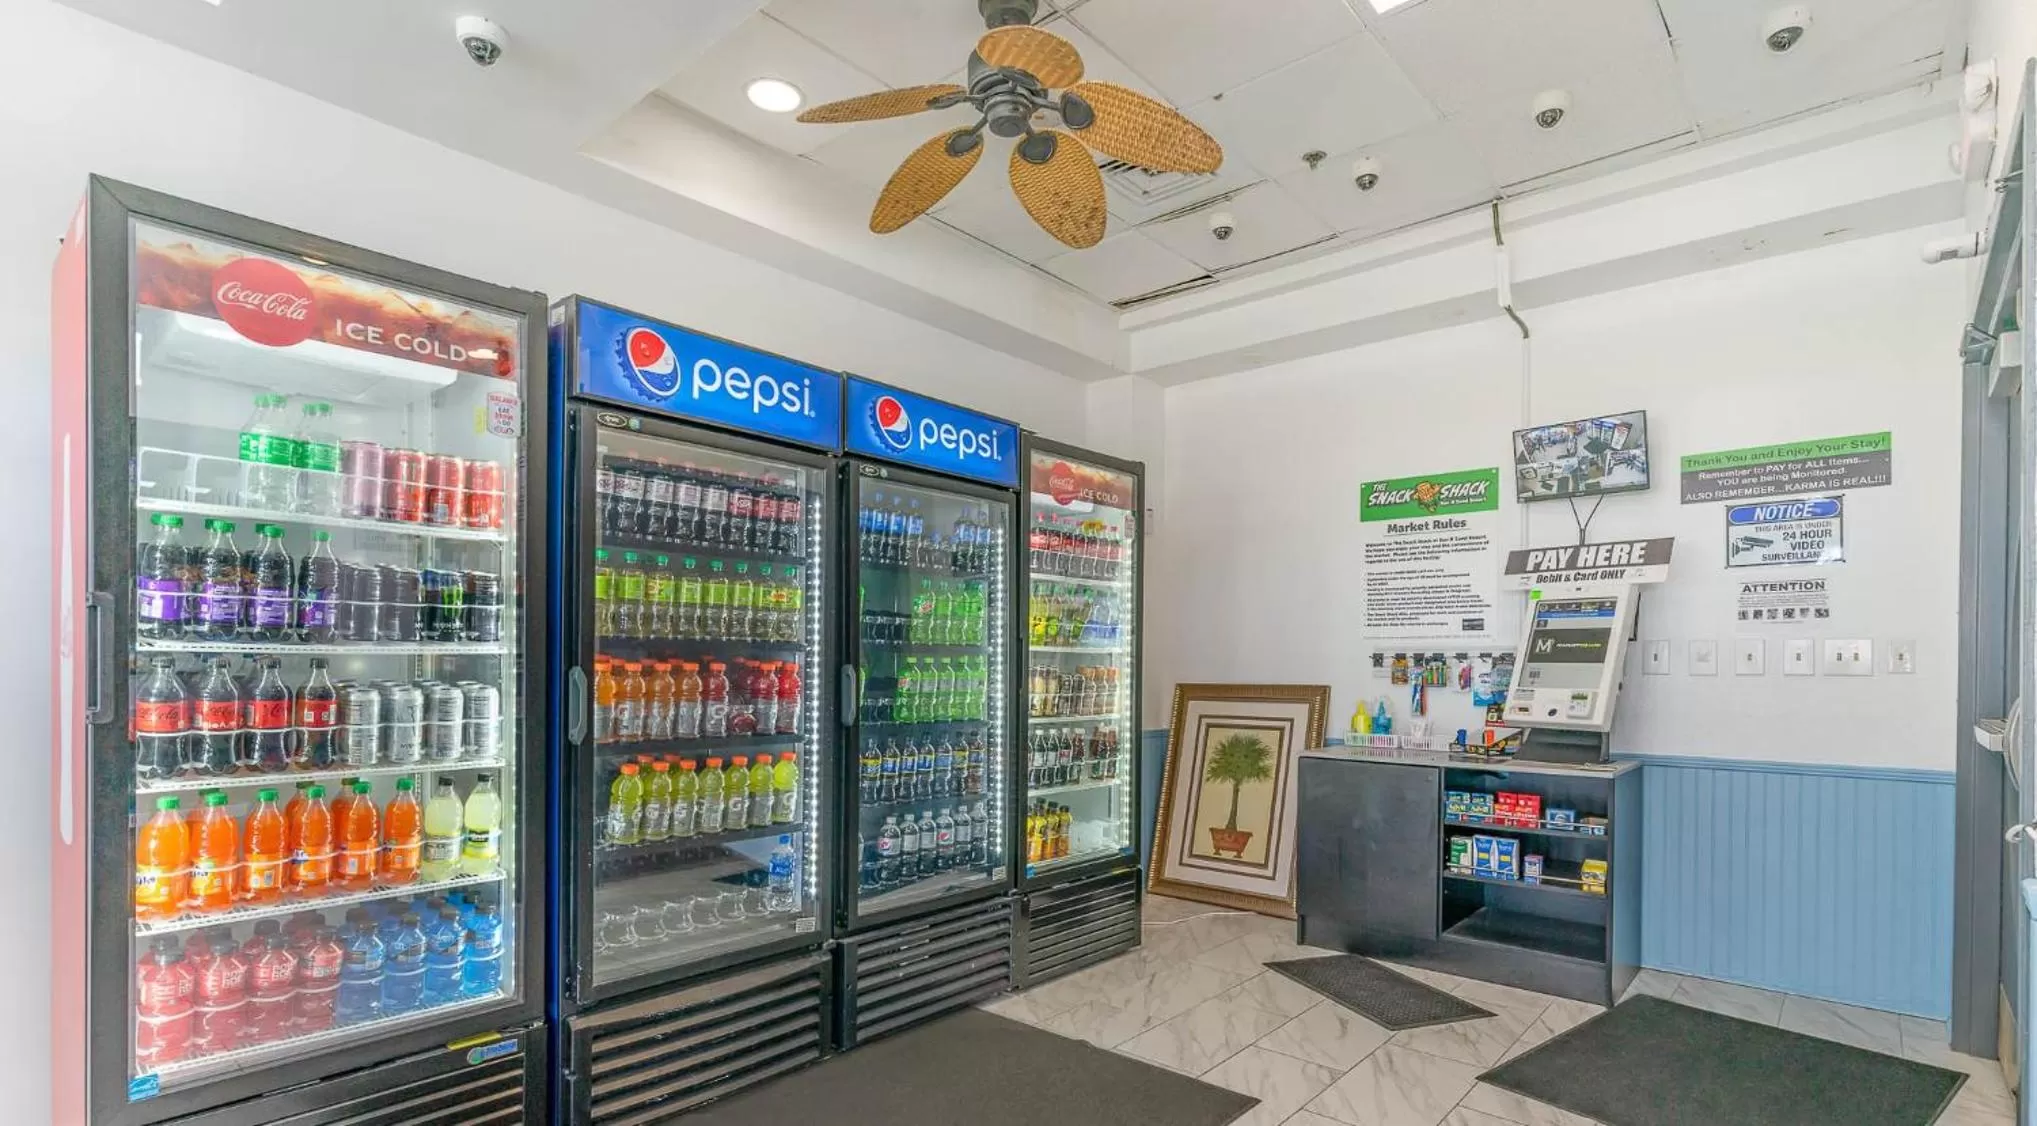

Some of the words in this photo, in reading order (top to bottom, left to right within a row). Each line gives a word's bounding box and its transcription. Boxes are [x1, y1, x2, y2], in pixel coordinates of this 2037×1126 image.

[216, 281, 312, 321] Coca-Cola
[335, 318, 384, 345] ICE
[394, 332, 468, 362] COLD
[692, 357, 814, 418] pepsi
[919, 416, 1001, 461] pepsi
[1686, 455, 1721, 468] Thank
[1725, 454, 1748, 464] You
[1751, 450, 1774, 461] and
[1777, 446, 1813, 458] Enjoy
[1816, 443, 1848, 453] Your
[1850, 435, 1886, 449] Stay!
[1699, 468, 1752, 481] Remember
[1754, 466, 1764, 475] to
[1766, 462, 1787, 473] PAY
[1788, 462, 1802, 471] for
[1805, 460, 1827, 469] ALL
[1717, 476, 1740, 487] YOU
[1741, 476, 1758, 485] are
[1759, 472, 1789, 484] being
[1080, 488, 1094, 499] ICE
[1096, 491, 1119, 504] COLD
[1368, 489, 1416, 507] SNACK
[1440, 480, 1490, 498] SHACK
[1685, 490, 1713, 501] ALSO
[1829, 478, 1840, 489] IS
[1843, 474, 1886, 486] REAL!!!
[1753, 502, 1815, 522] NOTICE
[1387, 521, 1430, 534] Market
[1433, 518, 1467, 530] Rules
[1755, 525, 1772, 533] THIS
[1773, 523, 1794, 532] AREA
[1804, 520, 1833, 530] UNDER
[1782, 531, 1797, 541] 24
[1799, 529, 1833, 540] HOUR
[1790, 540, 1825, 551] VIDEO
[1525, 547, 1574, 572] PAY
[1576, 541, 1648, 568] HERE
[1535, 572, 1563, 584] Debit
[1563, 574, 1571, 582] &
[1573, 570, 1598, 582] Card
[1599, 568, 1626, 581] ONLY
[1742, 581, 1825, 593] ATTENTION
